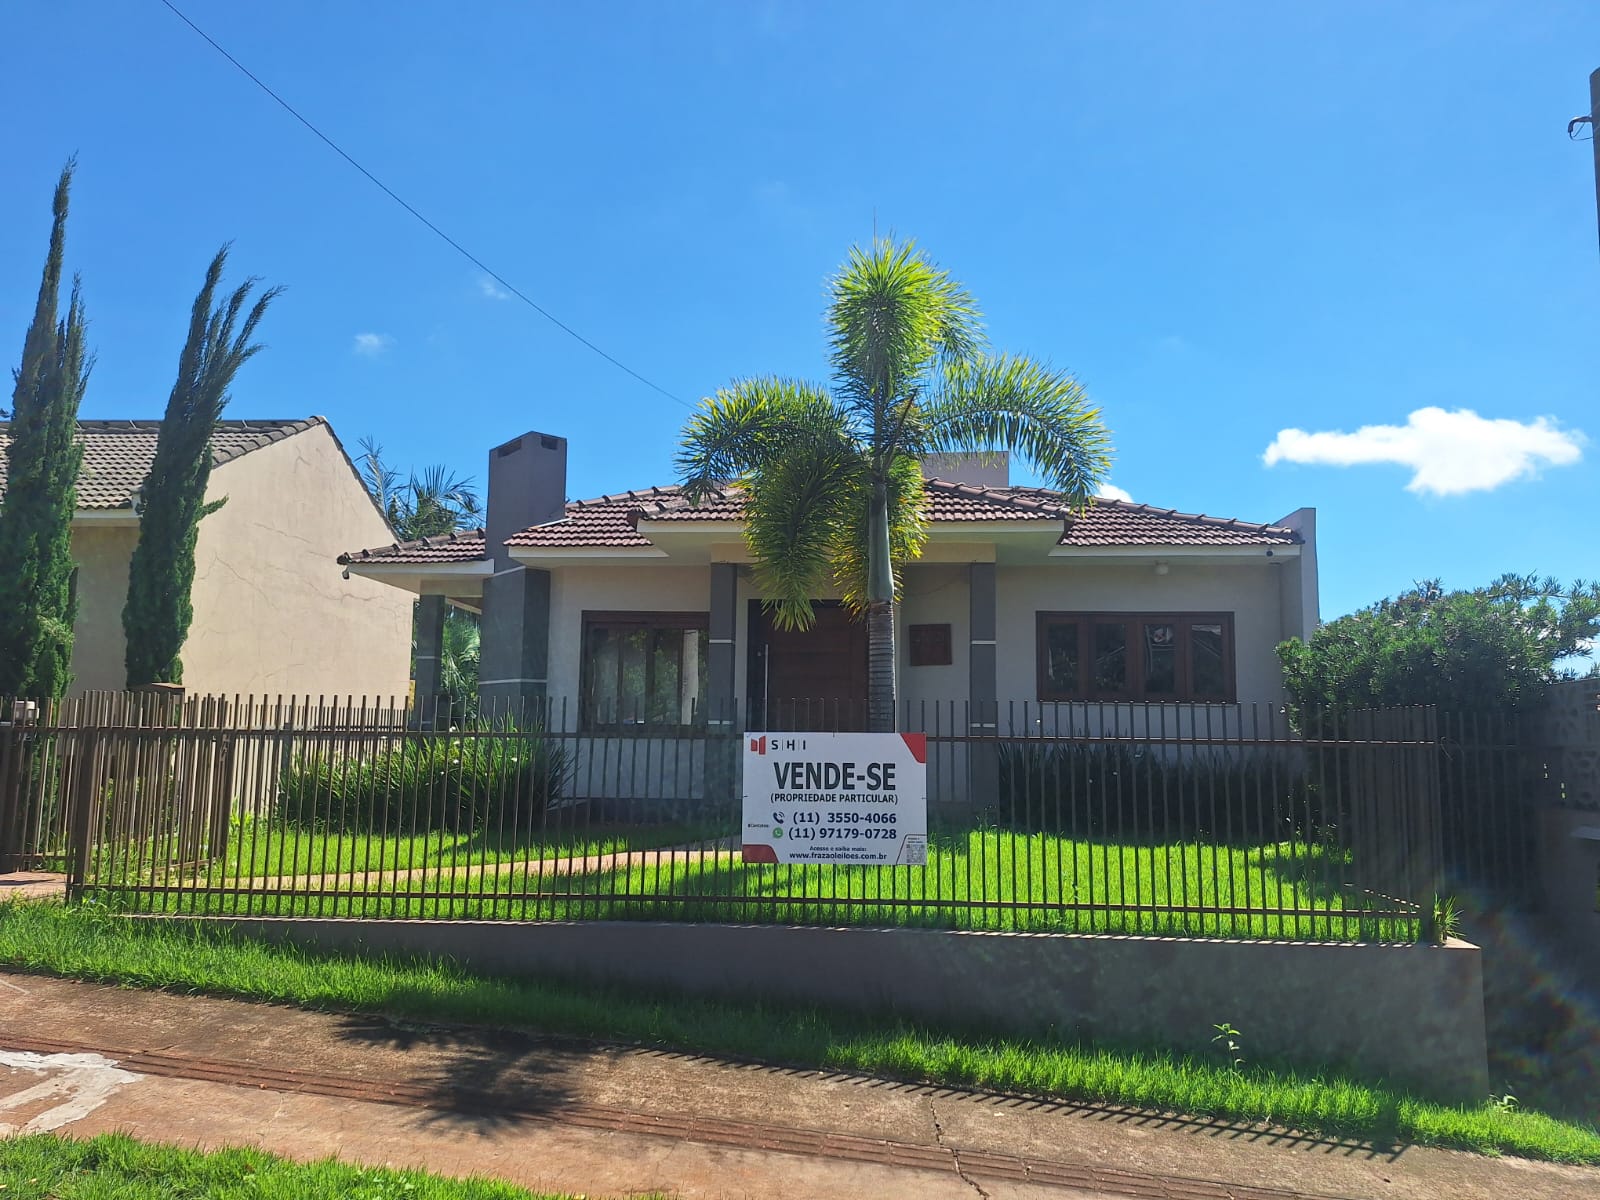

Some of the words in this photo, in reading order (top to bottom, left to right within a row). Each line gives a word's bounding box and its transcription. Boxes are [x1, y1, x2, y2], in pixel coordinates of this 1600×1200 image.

[773, 762, 896, 790] VENDE-SE
[770, 793, 836, 803] (PROPRIEDADE
[839, 794, 898, 805] PARTICULAR)
[793, 812, 819, 825] (11)
[828, 812, 897, 823] 3550-4066
[788, 827, 815, 840] (11)
[820, 828, 897, 839] 97179-0728
[790, 852, 887, 860] www.frazaoleiloes.com.br
